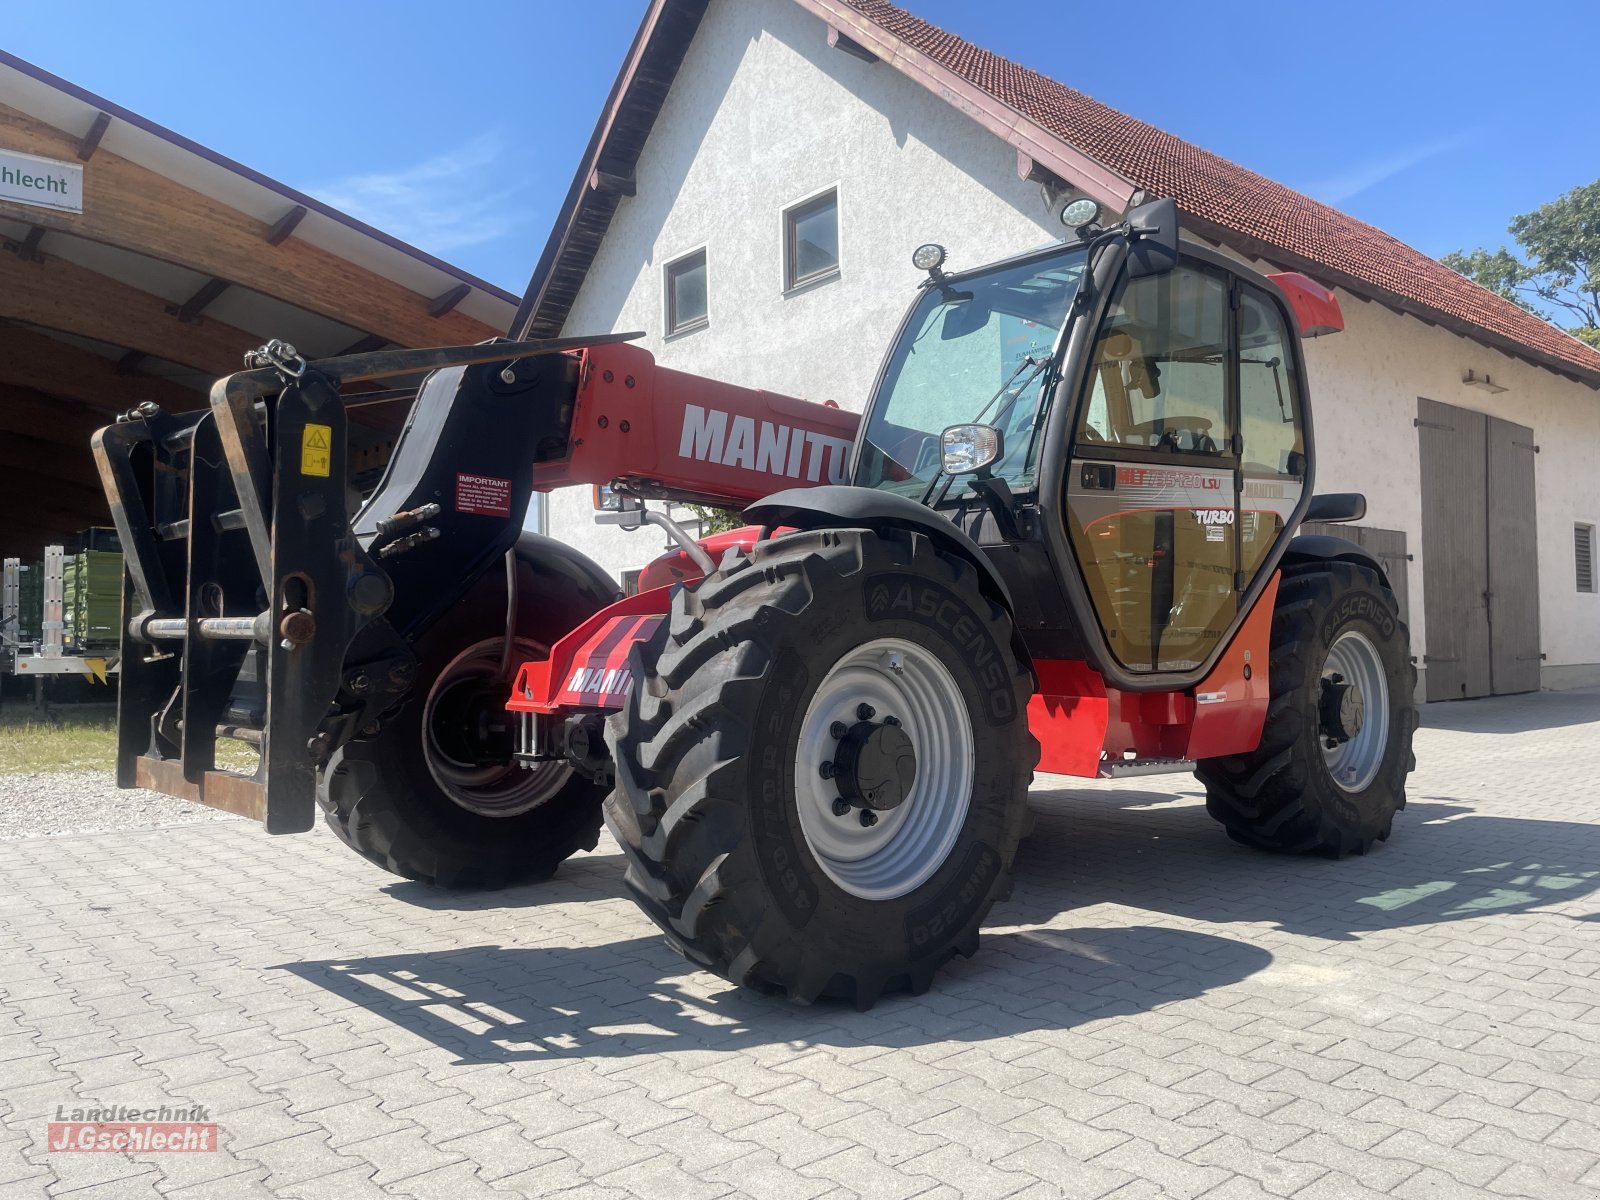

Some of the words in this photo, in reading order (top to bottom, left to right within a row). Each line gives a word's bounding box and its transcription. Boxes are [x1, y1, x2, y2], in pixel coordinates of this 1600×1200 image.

[459, 475, 509, 488] IMPORTANT
[1196, 510, 1235, 525] TURBO
[1331, 597, 1394, 637] ASCENSO
[891, 583, 1013, 718] ASCENSO
